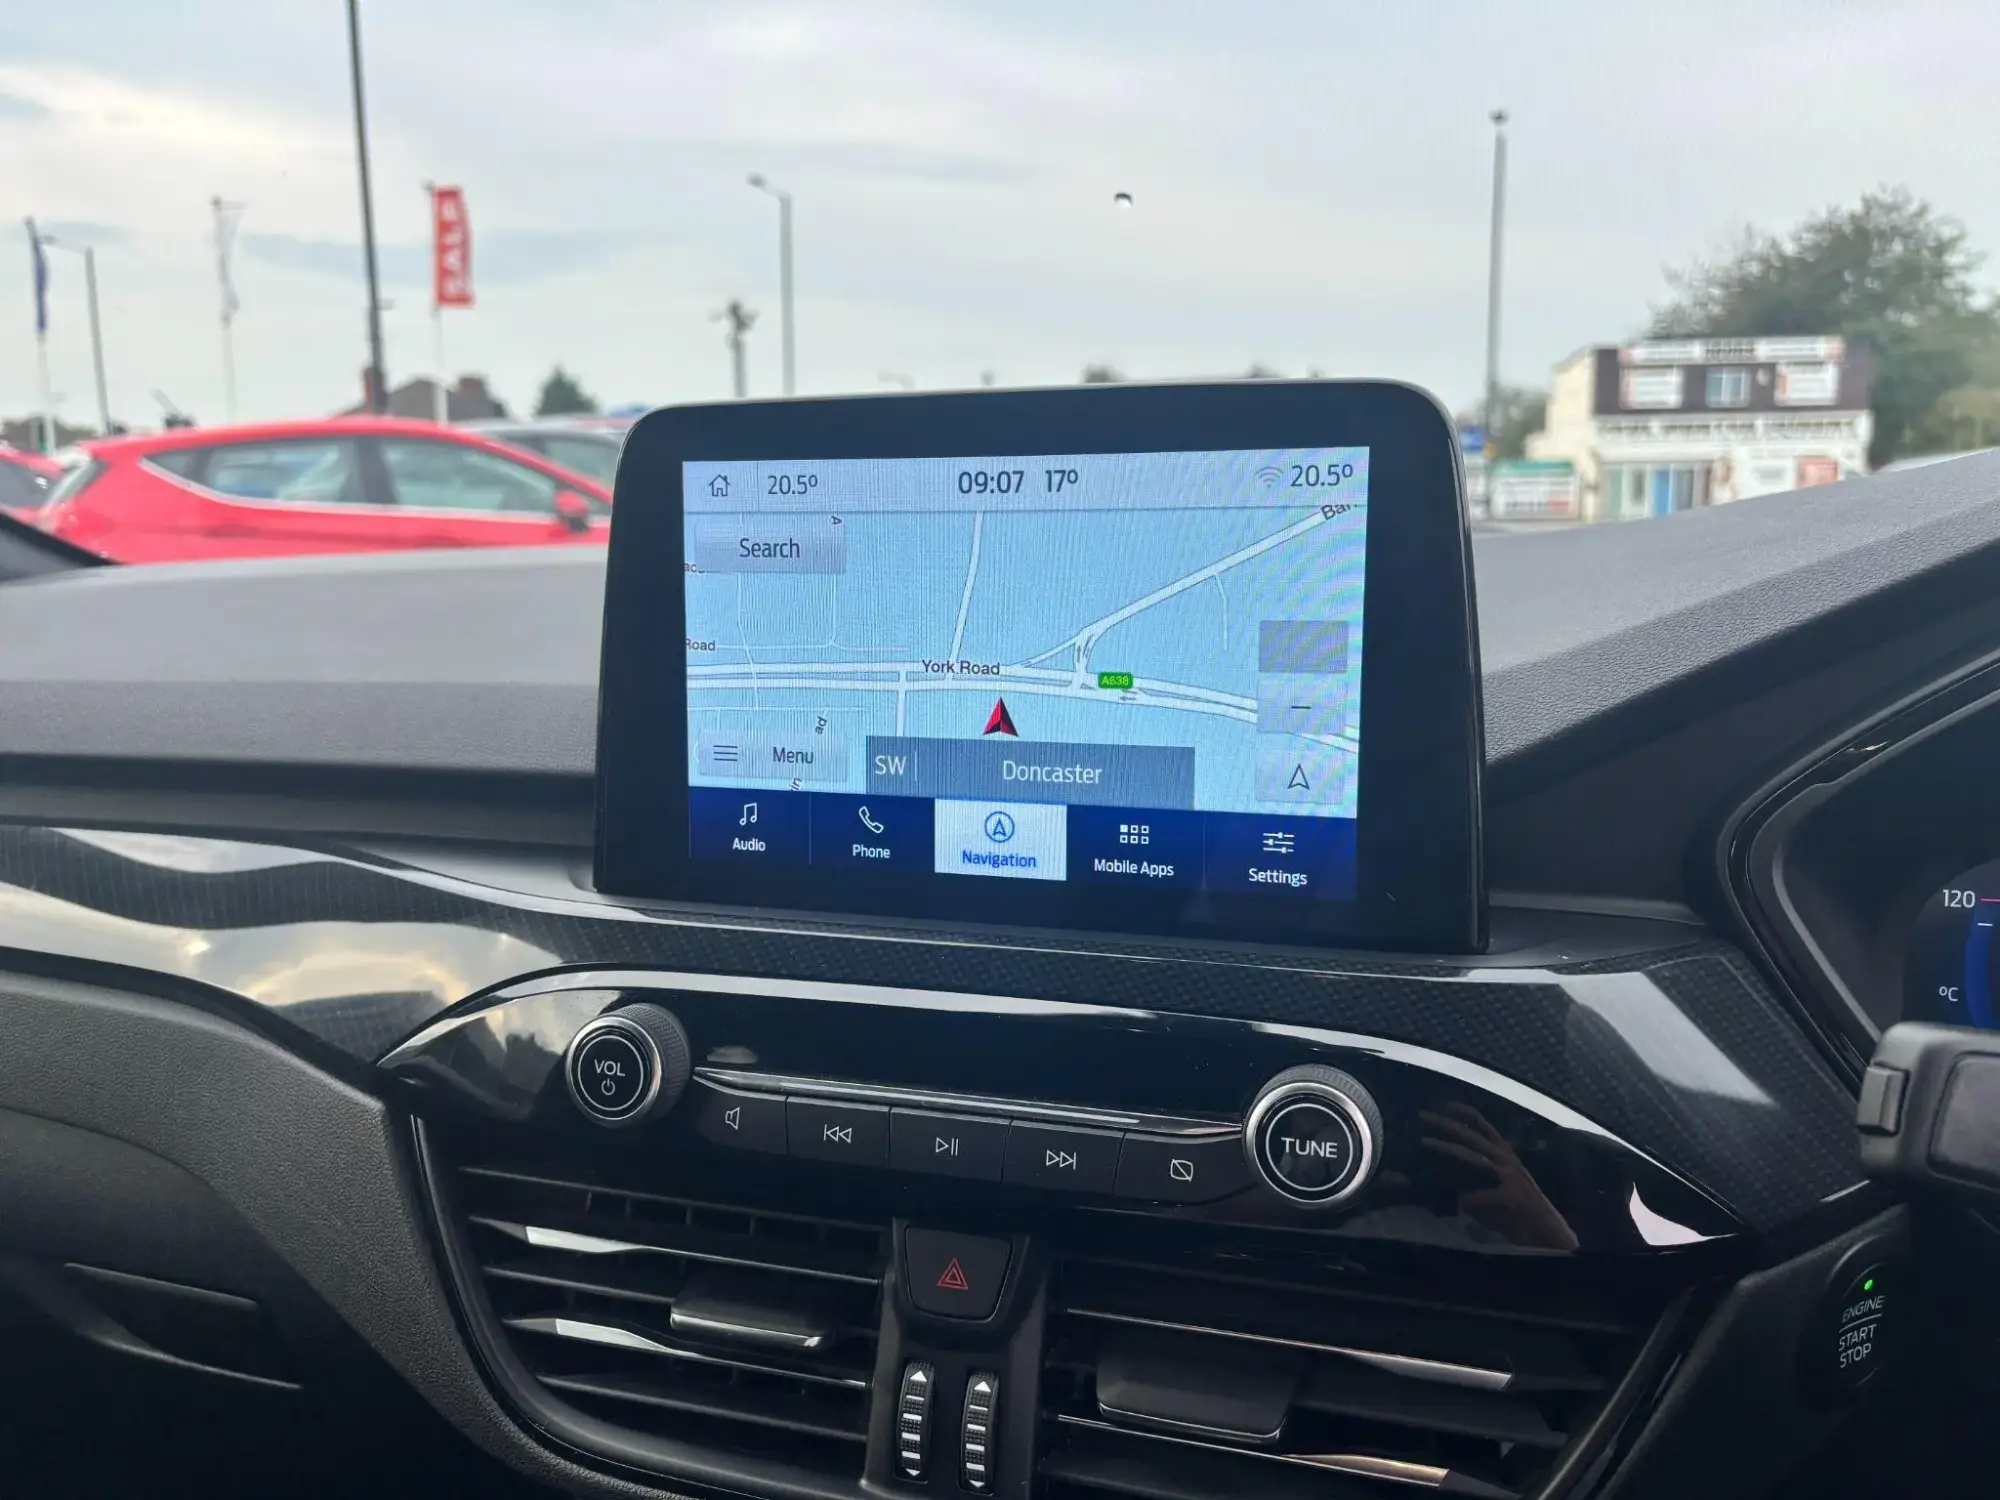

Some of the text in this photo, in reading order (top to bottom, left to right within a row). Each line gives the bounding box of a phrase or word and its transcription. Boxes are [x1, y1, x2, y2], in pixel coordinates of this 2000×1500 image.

[957, 470, 1025, 495] 09:07
[739, 537, 801, 559] Search
[685, 638, 716, 651] Road
[921, 660, 1001, 676] York Road
[1101, 675, 1129, 687] A638
[772, 746, 814, 764] Menu
[875, 755, 907, 776] SW
[1003, 760, 1103, 785] Doncaster
[732, 837, 766, 852] Audio
[852, 844, 891, 860] Phone
[961, 850, 1037, 869] Navigation
[1093, 858, 1175, 877] Mobile Apps
[1248, 867, 1308, 886] Settings
[1942, 888, 1976, 909] 120
[594, 1059, 626, 1077] VOL
[1280, 1136, 1338, 1159] TUNE
[1841, 1295, 1886, 1324] ENGINE
[1838, 1323, 1878, 1352] START
[1839, 1342, 1872, 1369] STOP
